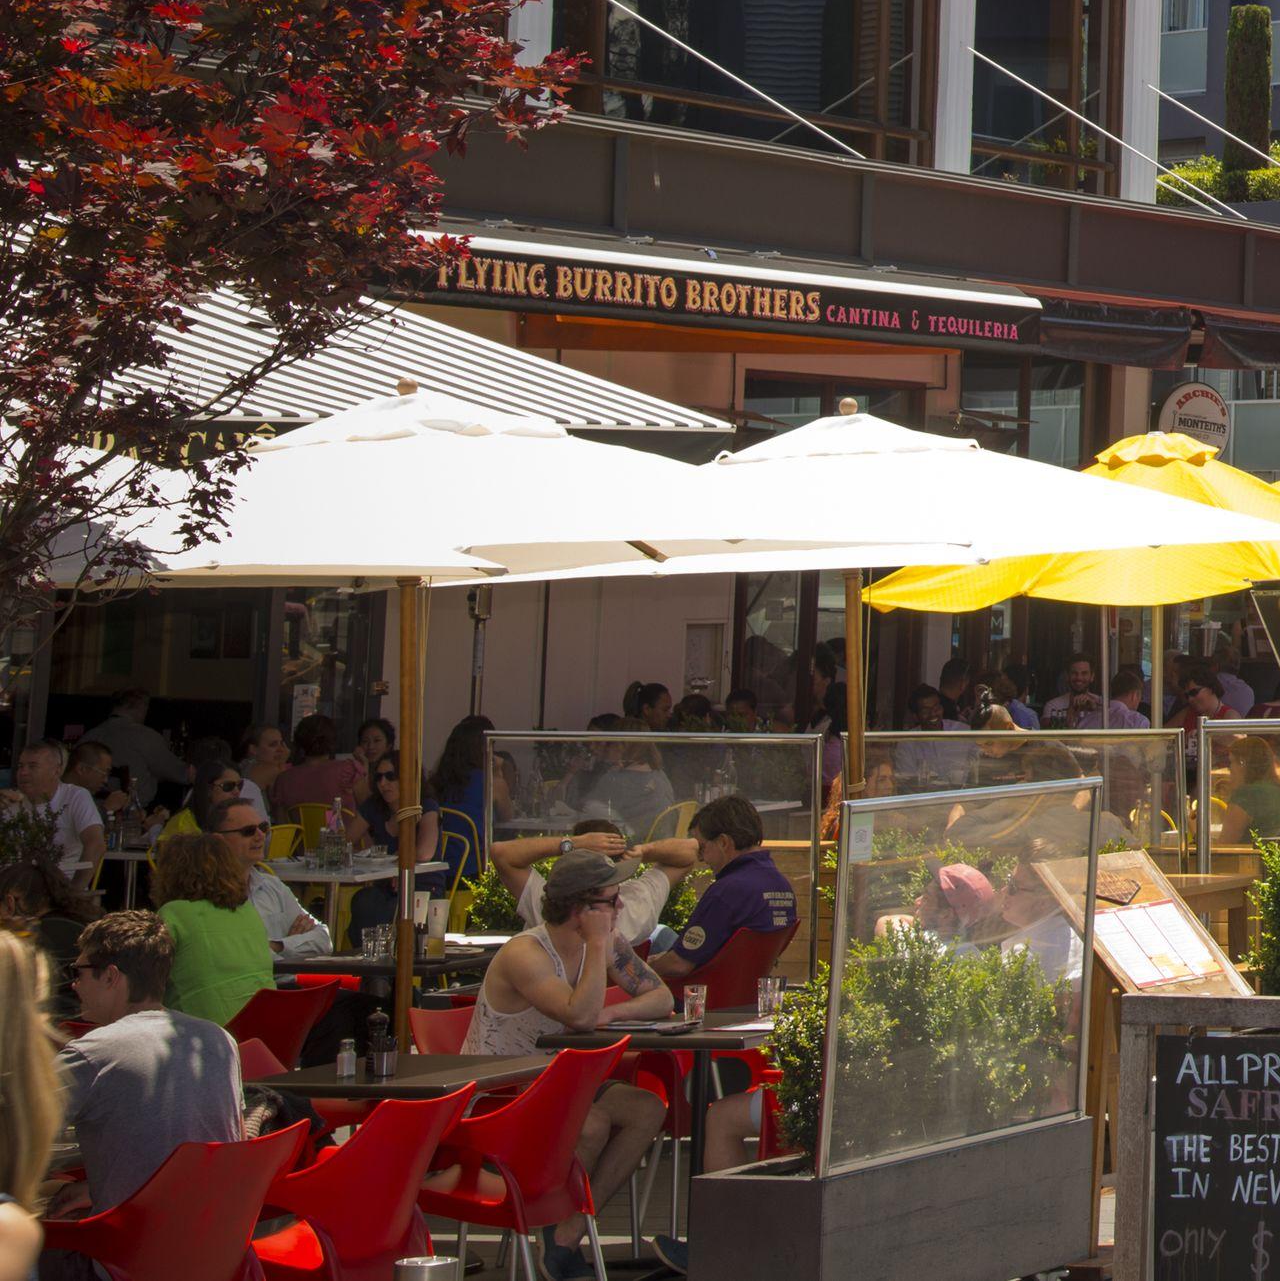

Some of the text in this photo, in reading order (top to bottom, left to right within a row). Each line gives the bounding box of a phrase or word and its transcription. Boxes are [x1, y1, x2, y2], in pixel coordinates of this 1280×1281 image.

[556, 266, 678, 309] BURRITO
[684, 278, 821, 323] BROTHERS
[826, 305, 901, 329] CANTINA
[928, 315, 1019, 340] TEQUILERIA
[1178, 417, 1227, 434] MONTEITH'S
[1166, 1134, 1212, 1163] THE
[1170, 1167, 1210, 1199] IN
